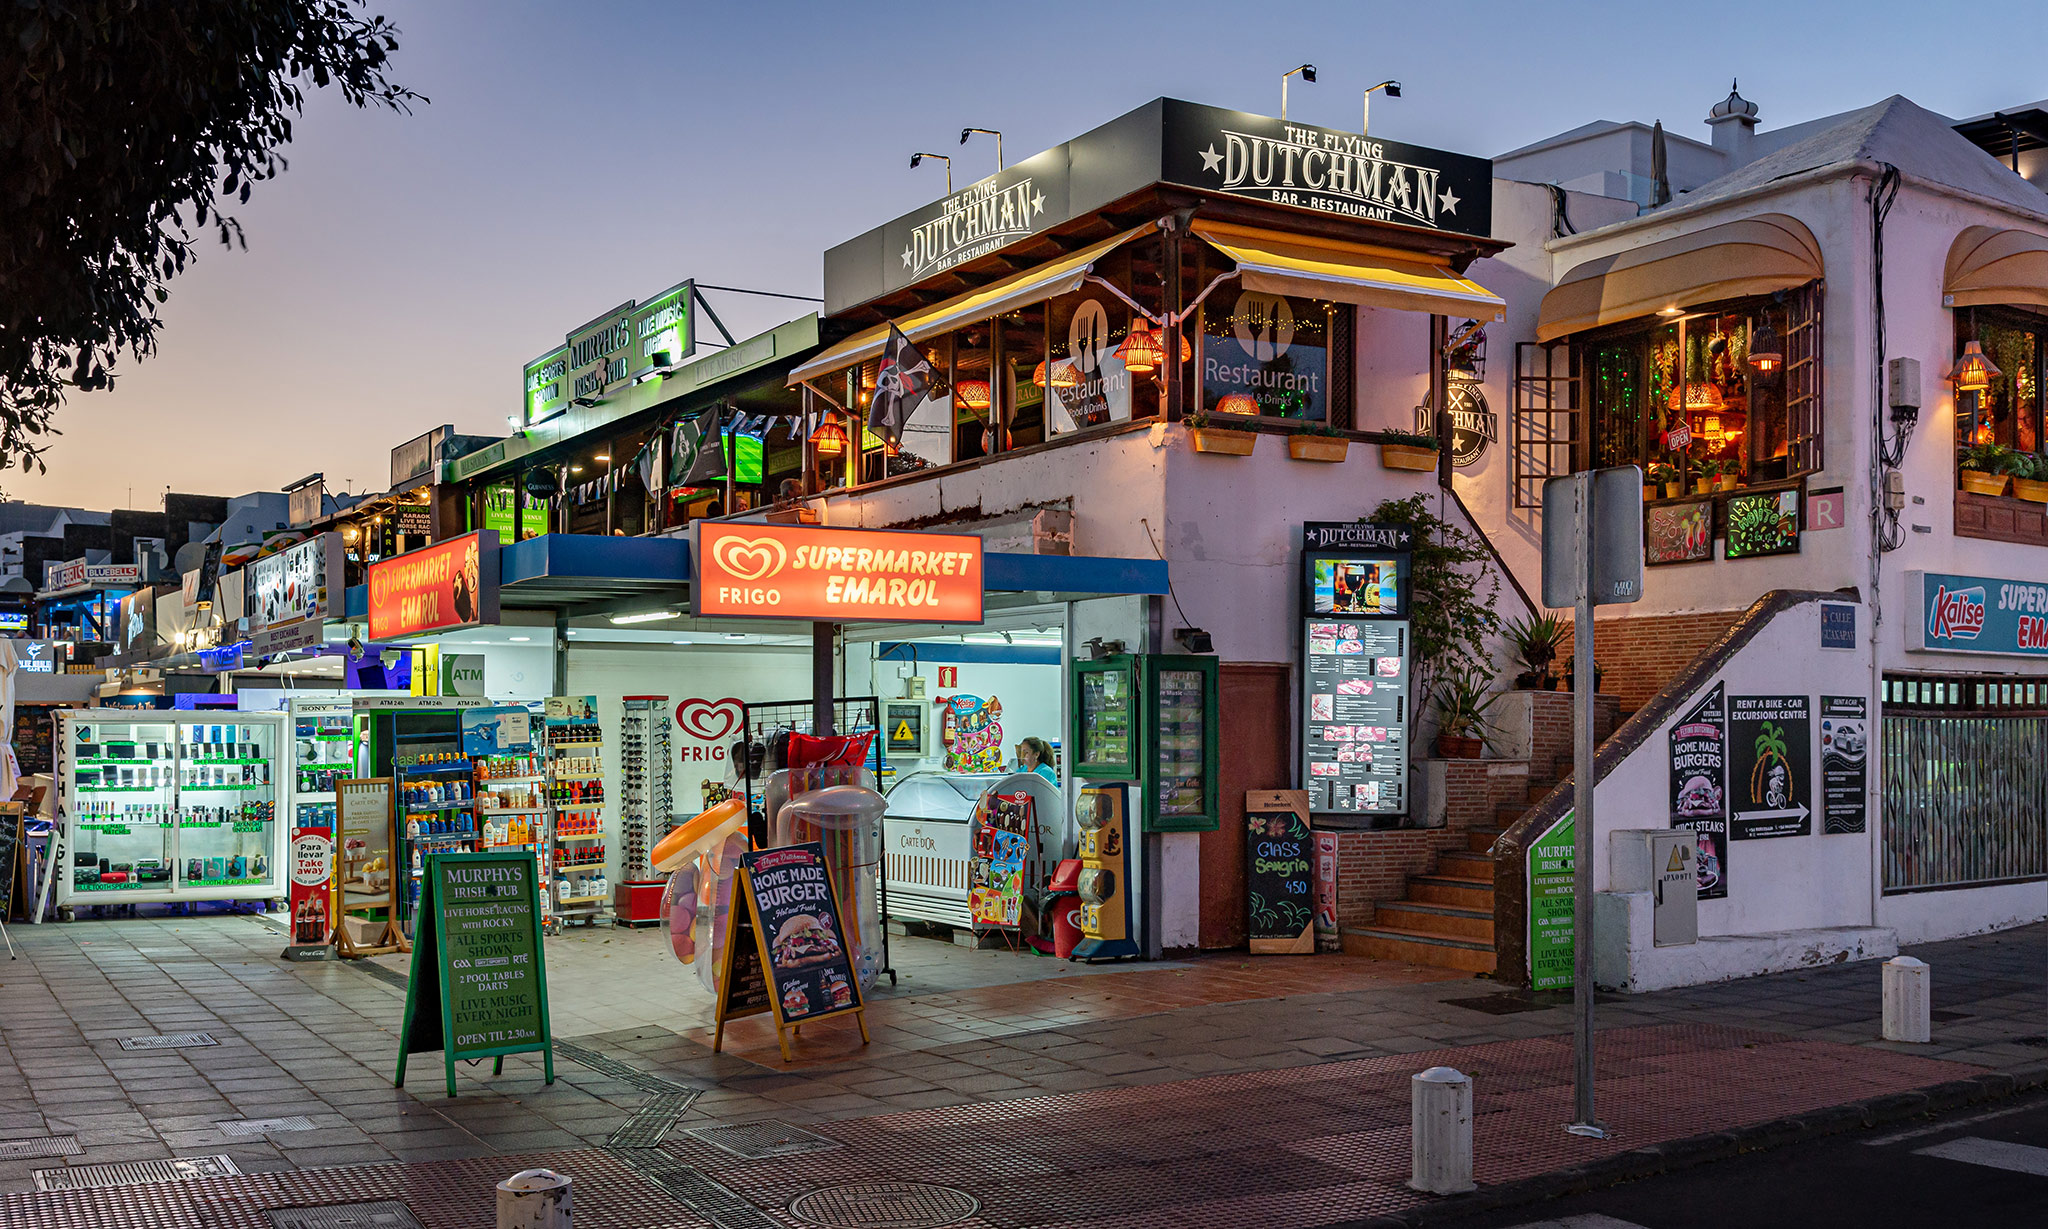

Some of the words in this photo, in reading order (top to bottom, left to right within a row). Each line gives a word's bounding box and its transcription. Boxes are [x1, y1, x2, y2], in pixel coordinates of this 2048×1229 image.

[1284, 125, 1318, 147] THE
[1323, 133, 1383, 160] FLYING
[1223, 133, 1440, 223] DUTCHMAN
[942, 197, 961, 216] THE
[962, 179, 997, 206] FLYING
[1272, 189, 1298, 205] BAR
[1310, 196, 1393, 222] RESTAURANT
[912, 181, 1032, 274] DUTCHMAN
[937, 259, 952, 271] BAR
[957, 236, 1005, 265] RESTAURANT
[569, 317, 630, 372] MURPHY'S
[573, 370, 598, 399] IRISH
[607, 357, 628, 385] PUB
[1206, 358, 1319, 393] Restaurant
[1052, 371, 1125, 405] Restaurant
[1090, 401, 1108, 414] Drinks
[1265, 394, 1292, 406] Drinks
[1671, 432, 1689, 447] OPEN
[528, 482, 554, 491] GUINNESS
[1738, 508, 1779, 530] MOJITO
[1817, 500, 1836, 526] R
[1319, 529, 1397, 547] DUTCHMAN
[793, 545, 973, 576] SUPERMARKET
[51, 563, 85, 590] BLUEBELLS
[89, 567, 137, 577] BLUEBELLS
[391, 551, 452, 593] SUPERMARKET
[719, 586, 781, 606] FRIGO
[826, 575, 939, 608] EMAROL
[1998, 583, 2048, 614] SUPER
[400, 591, 439, 629] EMAROL
[1830, 612, 1852, 622] CALLE
[1934, 586, 1984, 639] Kalise
[372, 614, 389, 632] FRIGO
[453, 669, 483, 681] ATM
[1736, 699, 1758, 708] RENT
[1758, 699, 1765, 708] A
[1766, 699, 1782, 708] BIKE
[1788, 699, 1802, 708] CAR
[1732, 711, 1778, 720] EXCURSIONS
[1779, 710, 1807, 719] CENTRE
[681, 746, 729, 762] FRIG
[1675, 742, 1697, 755] HOME
[1699, 741, 1720, 753] MADE
[1674, 753, 1721, 770] BURGERS
[57, 718, 66, 881] EXCHANGE
[1695, 820, 1724, 833] STEAKS
[300, 843, 321, 852] Para
[900, 834, 919, 849] CARTE
[920, 836, 936, 851] D'OR
[297, 851, 324, 859] llevar
[761, 857, 779, 867] Flying
[780, 852, 807, 863] Dutchman
[297, 867, 324, 876] away
[298, 860, 323, 868] Take
[1541, 861, 1562, 870] IRISH
[222, 878, 261, 886] HEADPHONES
[447, 866, 523, 883] MURPHY'S
[753, 869, 789, 892] HOME
[789, 867, 824, 882] MADE
[1547, 877, 1565, 885] HORSE
[454, 886, 486, 899] IRISH
[497, 885, 518, 896] PUB
[756, 882, 828, 912] BURGER
[1557, 886, 1574, 894] ROCK
[444, 908, 464, 918] LIVE
[466, 906, 496, 917] HORSE
[496, 904, 530, 915] RACING
[1541, 900, 1553, 908] ALL
[1548, 908, 1575, 917] SHOWN
[462, 921, 481, 929] WITH
[483, 918, 515, 928] ROCKY
[456, 934, 479, 946] ALL
[480, 932, 523, 945] SPORTS
[1545, 929, 1559, 937] POOL
[1552, 936, 1570, 944] DARTS
[469, 944, 513, 958] SHOWN
[1541, 949, 1557, 959] LIVE
[1538, 958, 1564, 968] EVERY
[460, 975, 465, 984] 2
[466, 973, 491, 983] POOL
[492, 970, 525, 981] TABLES
[1538, 976, 1556, 986] OPEN
[1557, 975, 1567, 984] TIL
[478, 981, 509, 992] DARTS
[461, 998, 487, 1011] LIVE
[490, 994, 528, 1008] MUSIC
[456, 1010, 492, 1023] EVERY
[496, 1005, 532, 1019] NIGHT
[457, 1032, 487, 1046] OPEN
[488, 1031, 506, 1042] TIL
[508, 1028, 536, 1040] 2.30AM
